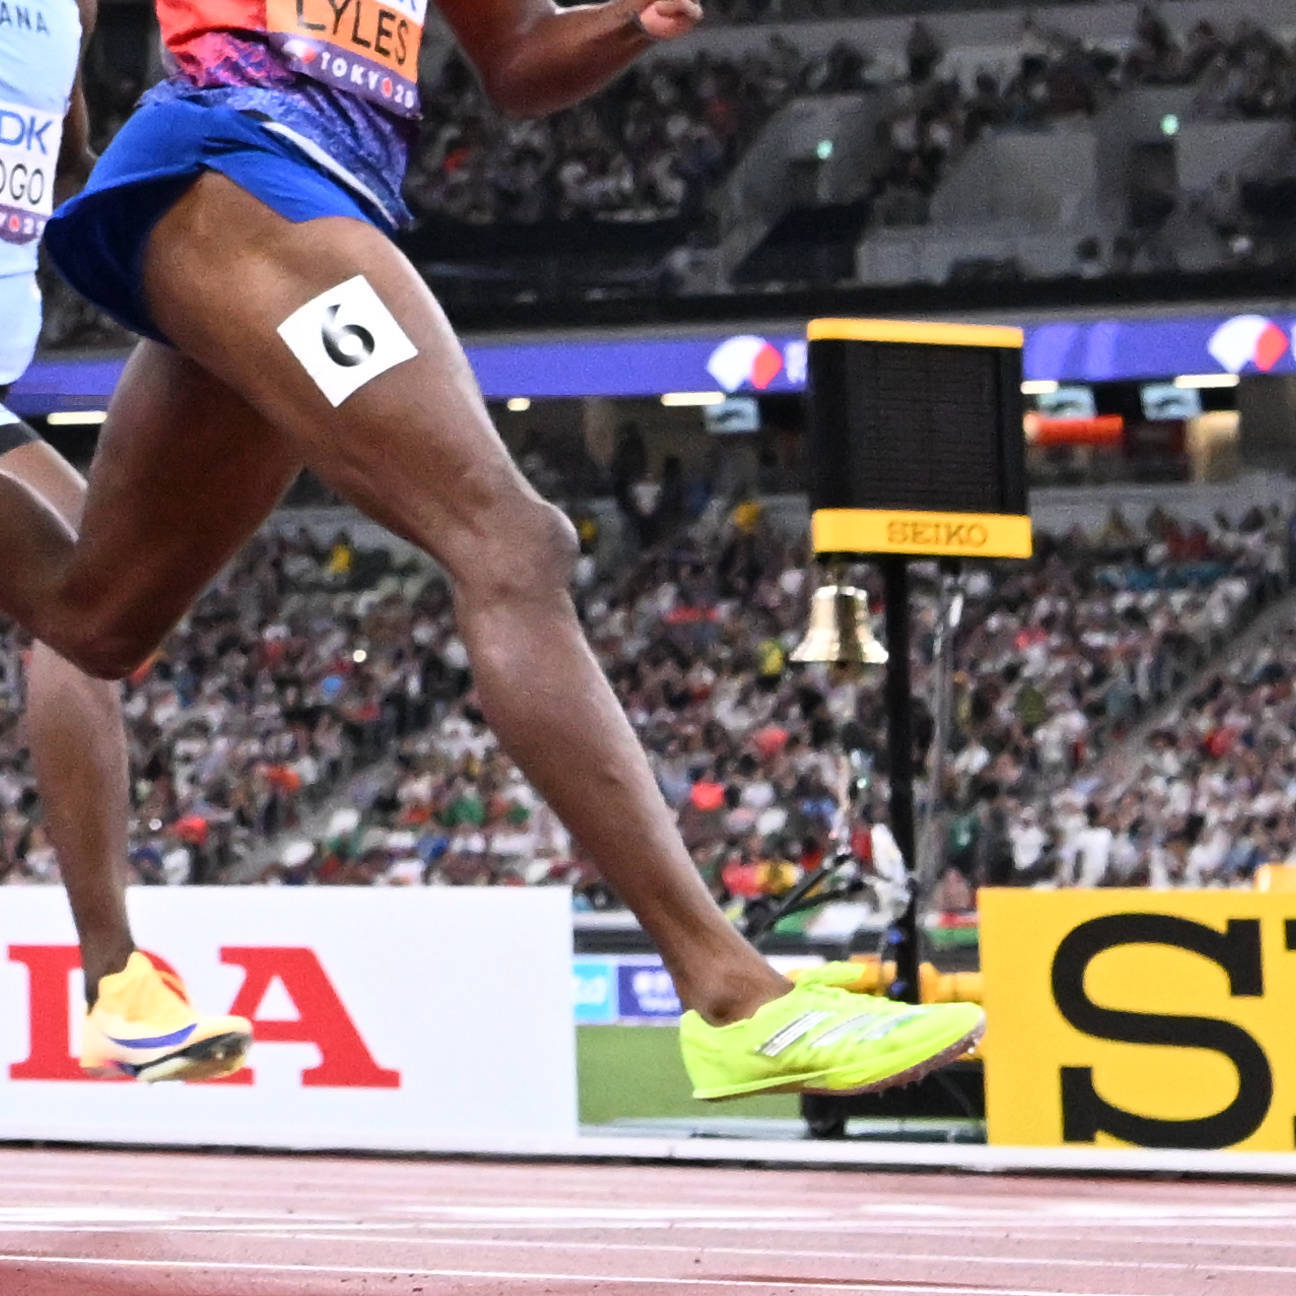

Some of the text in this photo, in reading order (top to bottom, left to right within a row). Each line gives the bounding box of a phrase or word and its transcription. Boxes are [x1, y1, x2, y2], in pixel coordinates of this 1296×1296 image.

[321, 304, 375, 368] 6
[887, 519, 988, 548] SEIKO
[1051, 913, 1296, 1150] S
